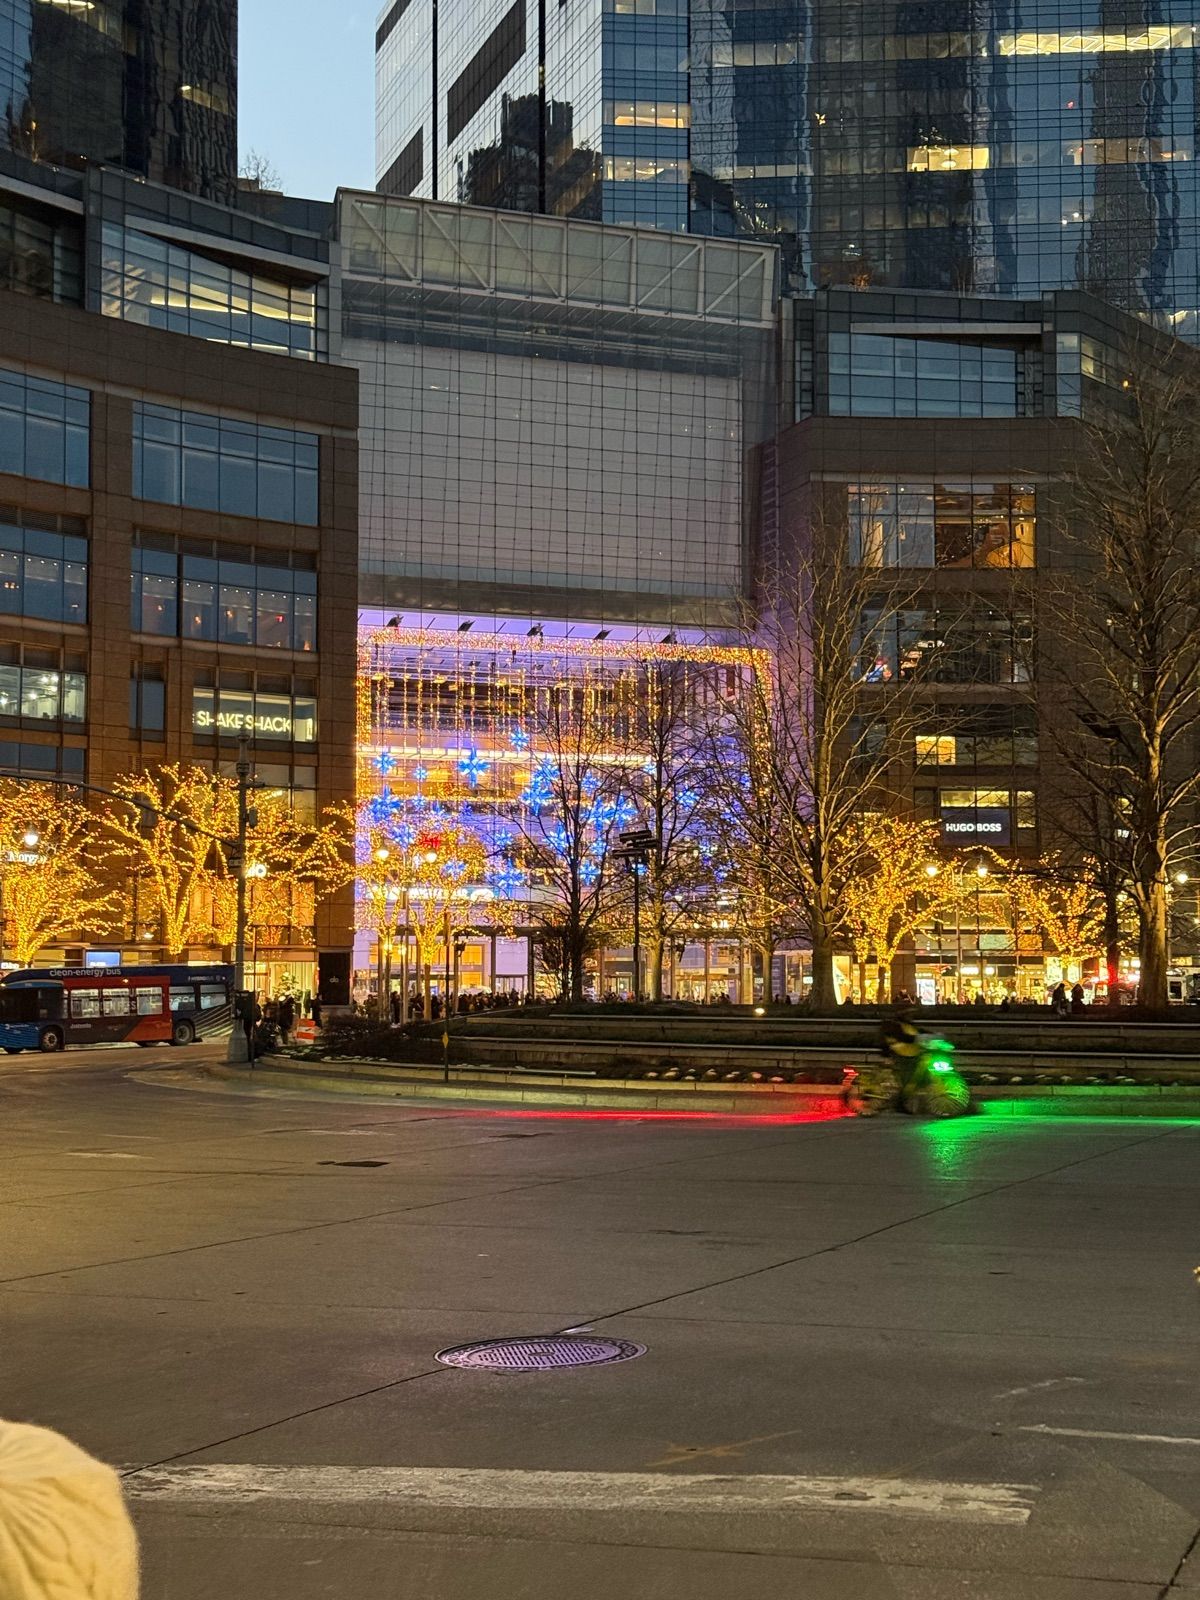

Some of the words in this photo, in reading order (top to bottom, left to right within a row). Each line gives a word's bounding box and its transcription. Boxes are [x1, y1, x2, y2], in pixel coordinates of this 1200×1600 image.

[197, 710, 243, 729] SHAKE
[245, 715, 290, 732] SHACK
[946, 823, 975, 832] HUGO
[976, 823, 1002, 832] BOSS
[49, 968, 104, 977] clean-energy
[106, 967, 121, 976] bus
